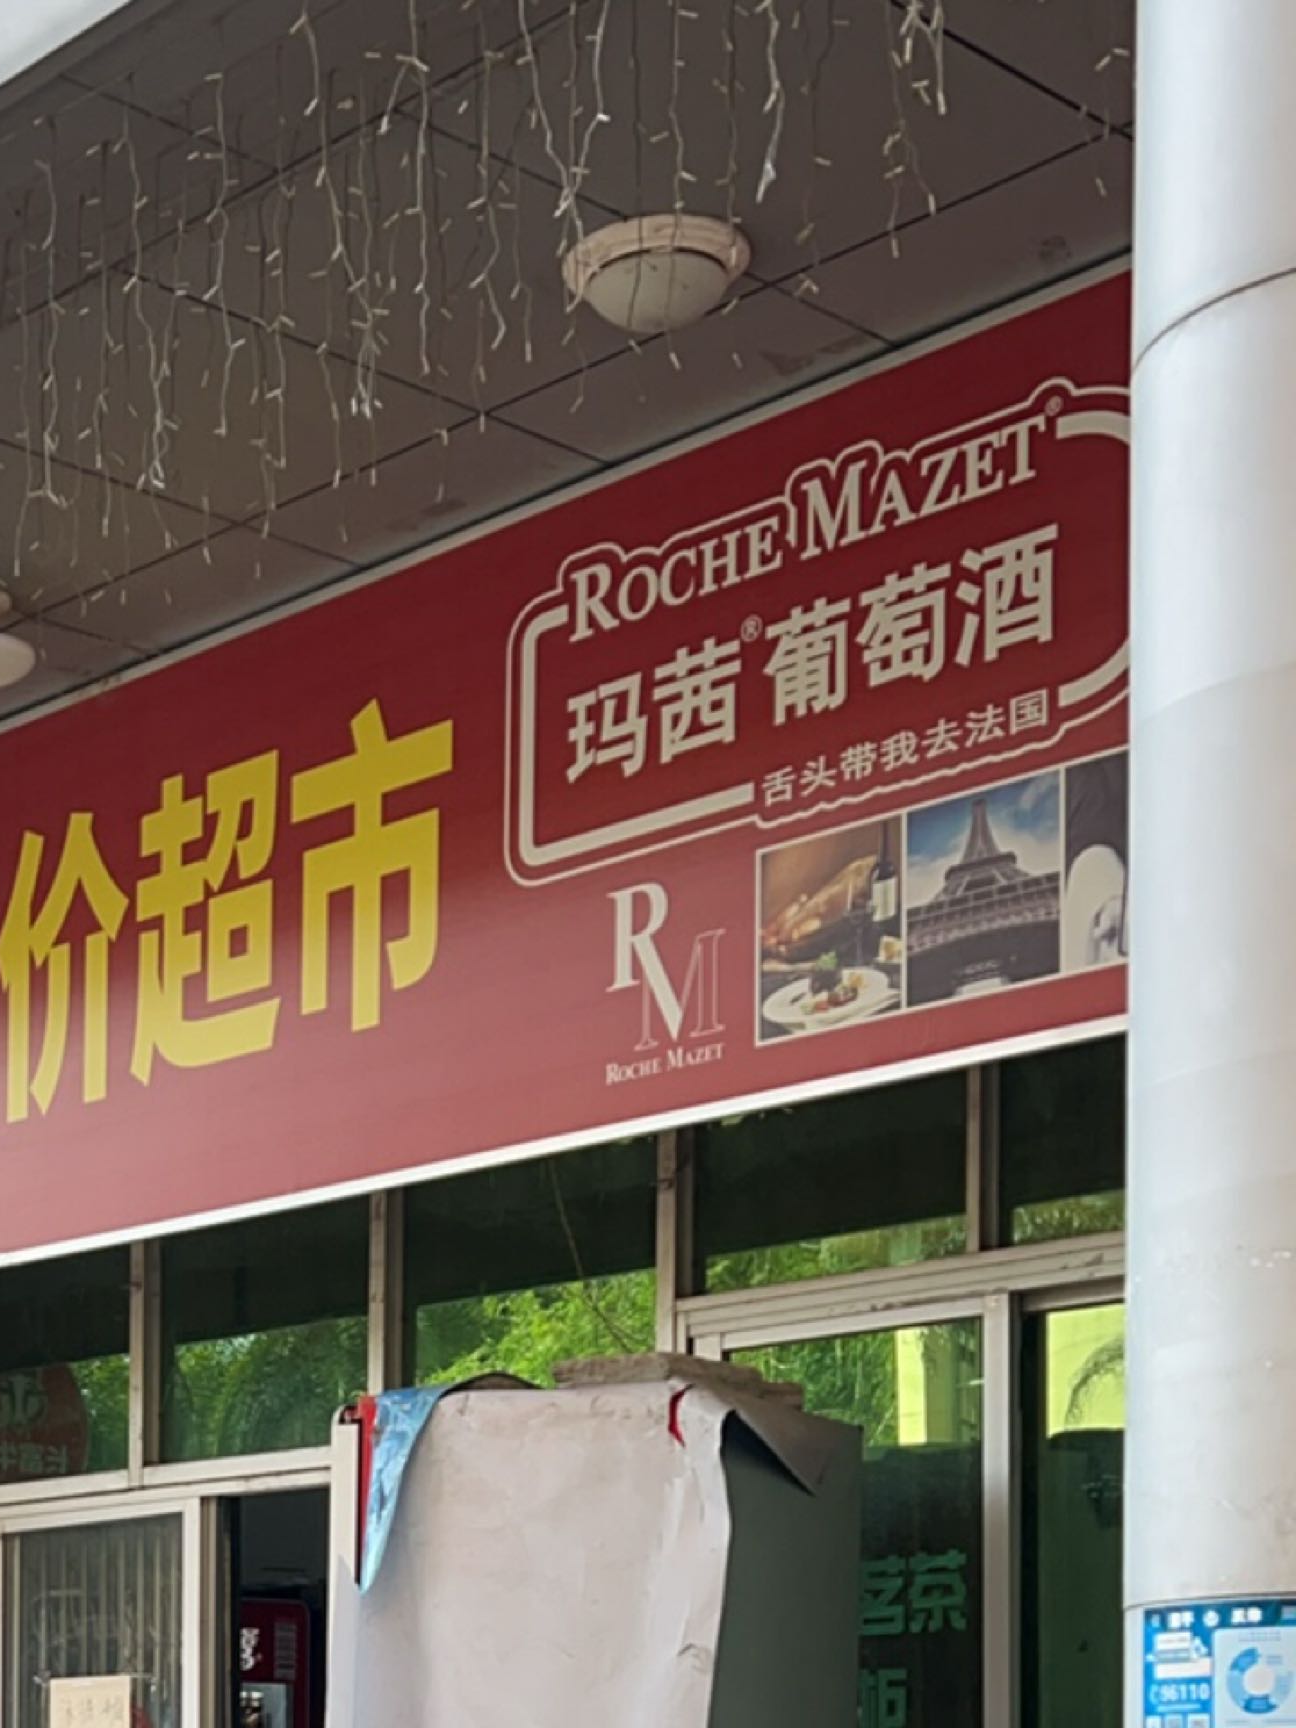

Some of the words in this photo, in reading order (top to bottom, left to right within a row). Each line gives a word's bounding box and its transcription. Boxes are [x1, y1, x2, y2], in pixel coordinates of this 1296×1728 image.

[569, 519, 785, 644] ROCHE
[763, 689, 1048, 807] 舌头带我去法国
